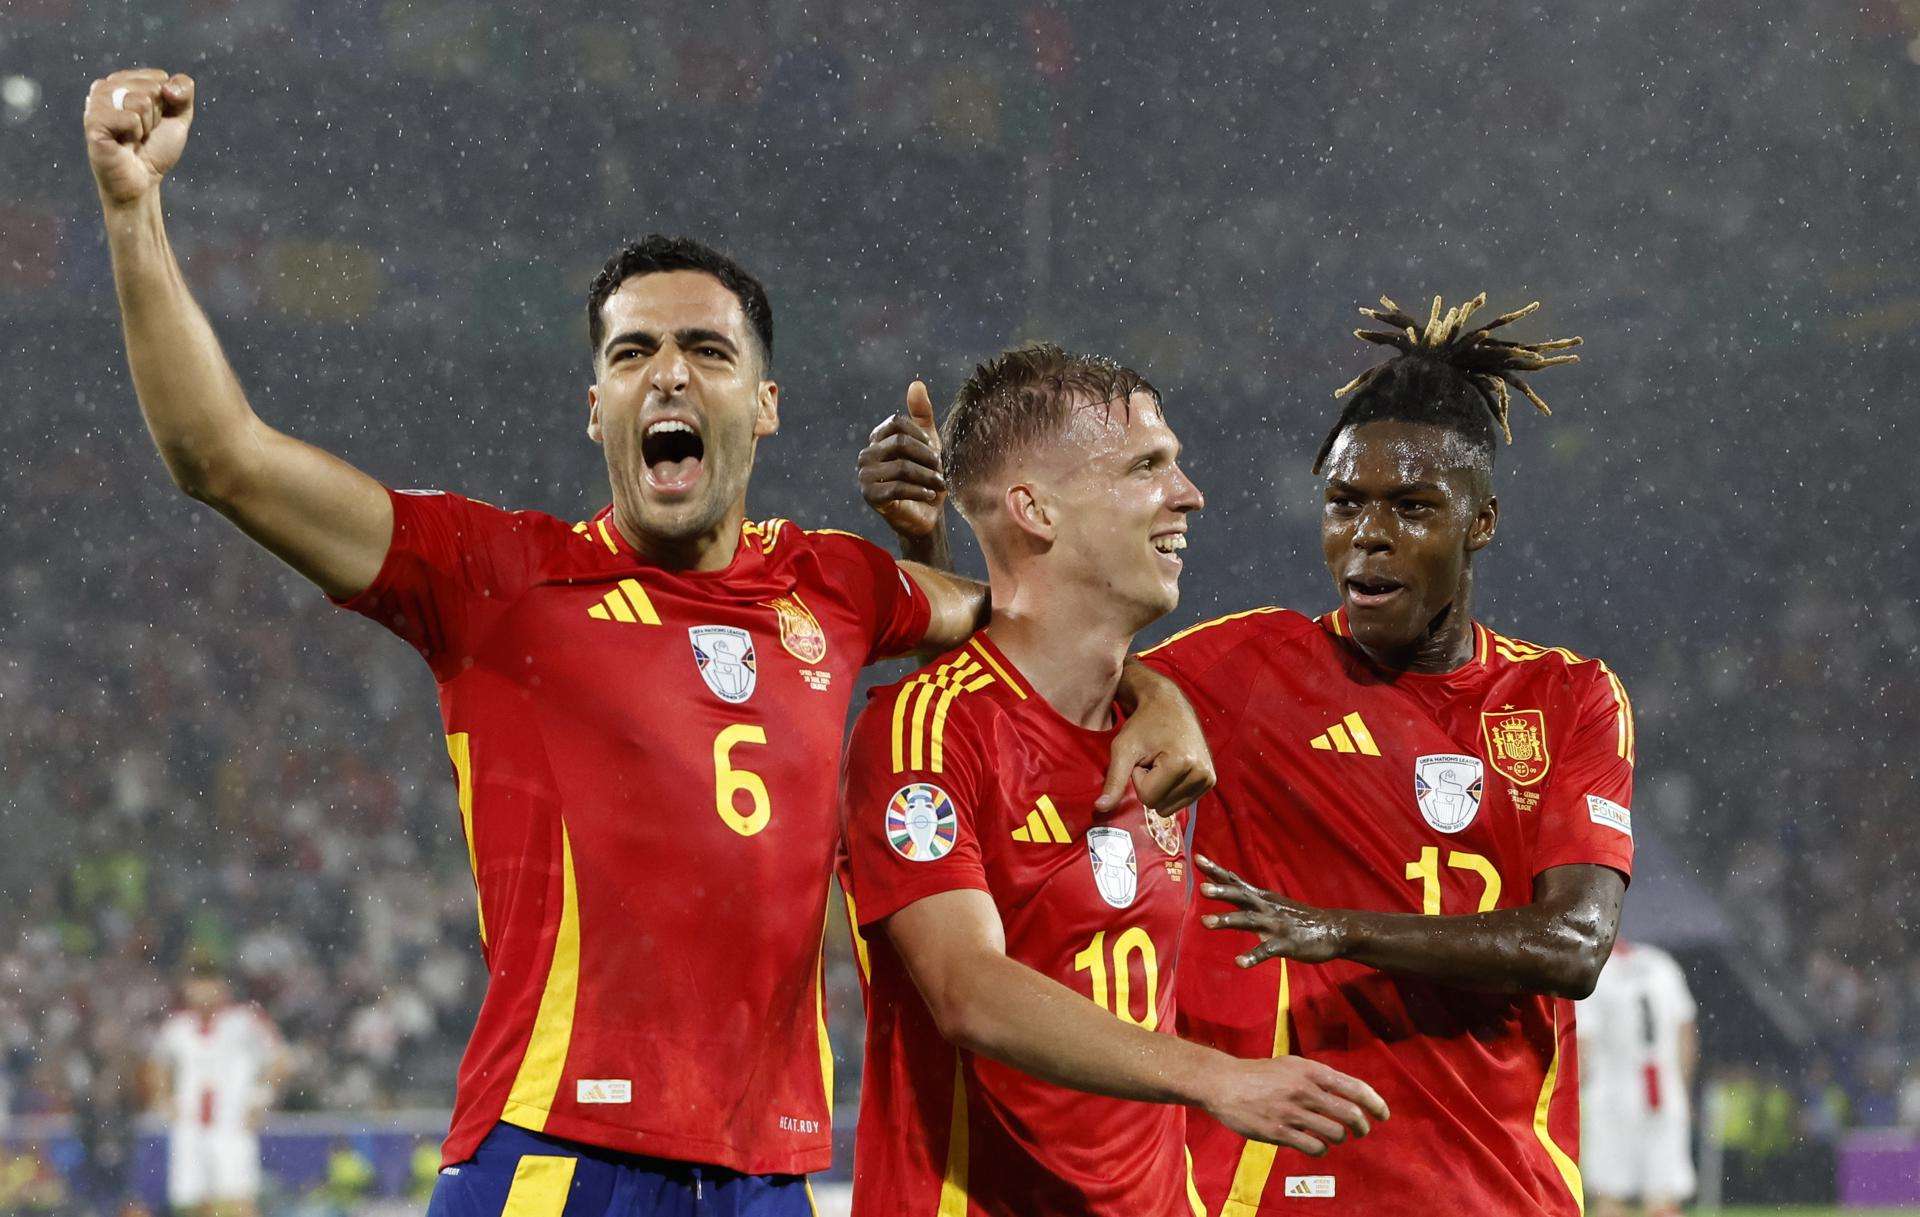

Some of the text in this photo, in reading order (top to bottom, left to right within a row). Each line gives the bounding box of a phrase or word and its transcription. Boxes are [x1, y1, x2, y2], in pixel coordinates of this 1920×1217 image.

[713, 724, 771, 836] 6
[1459, 757, 1480, 766] LEAGUE
[1074, 926, 1158, 1033] 10
[779, 1115, 819, 1134] HEAT.RDY
